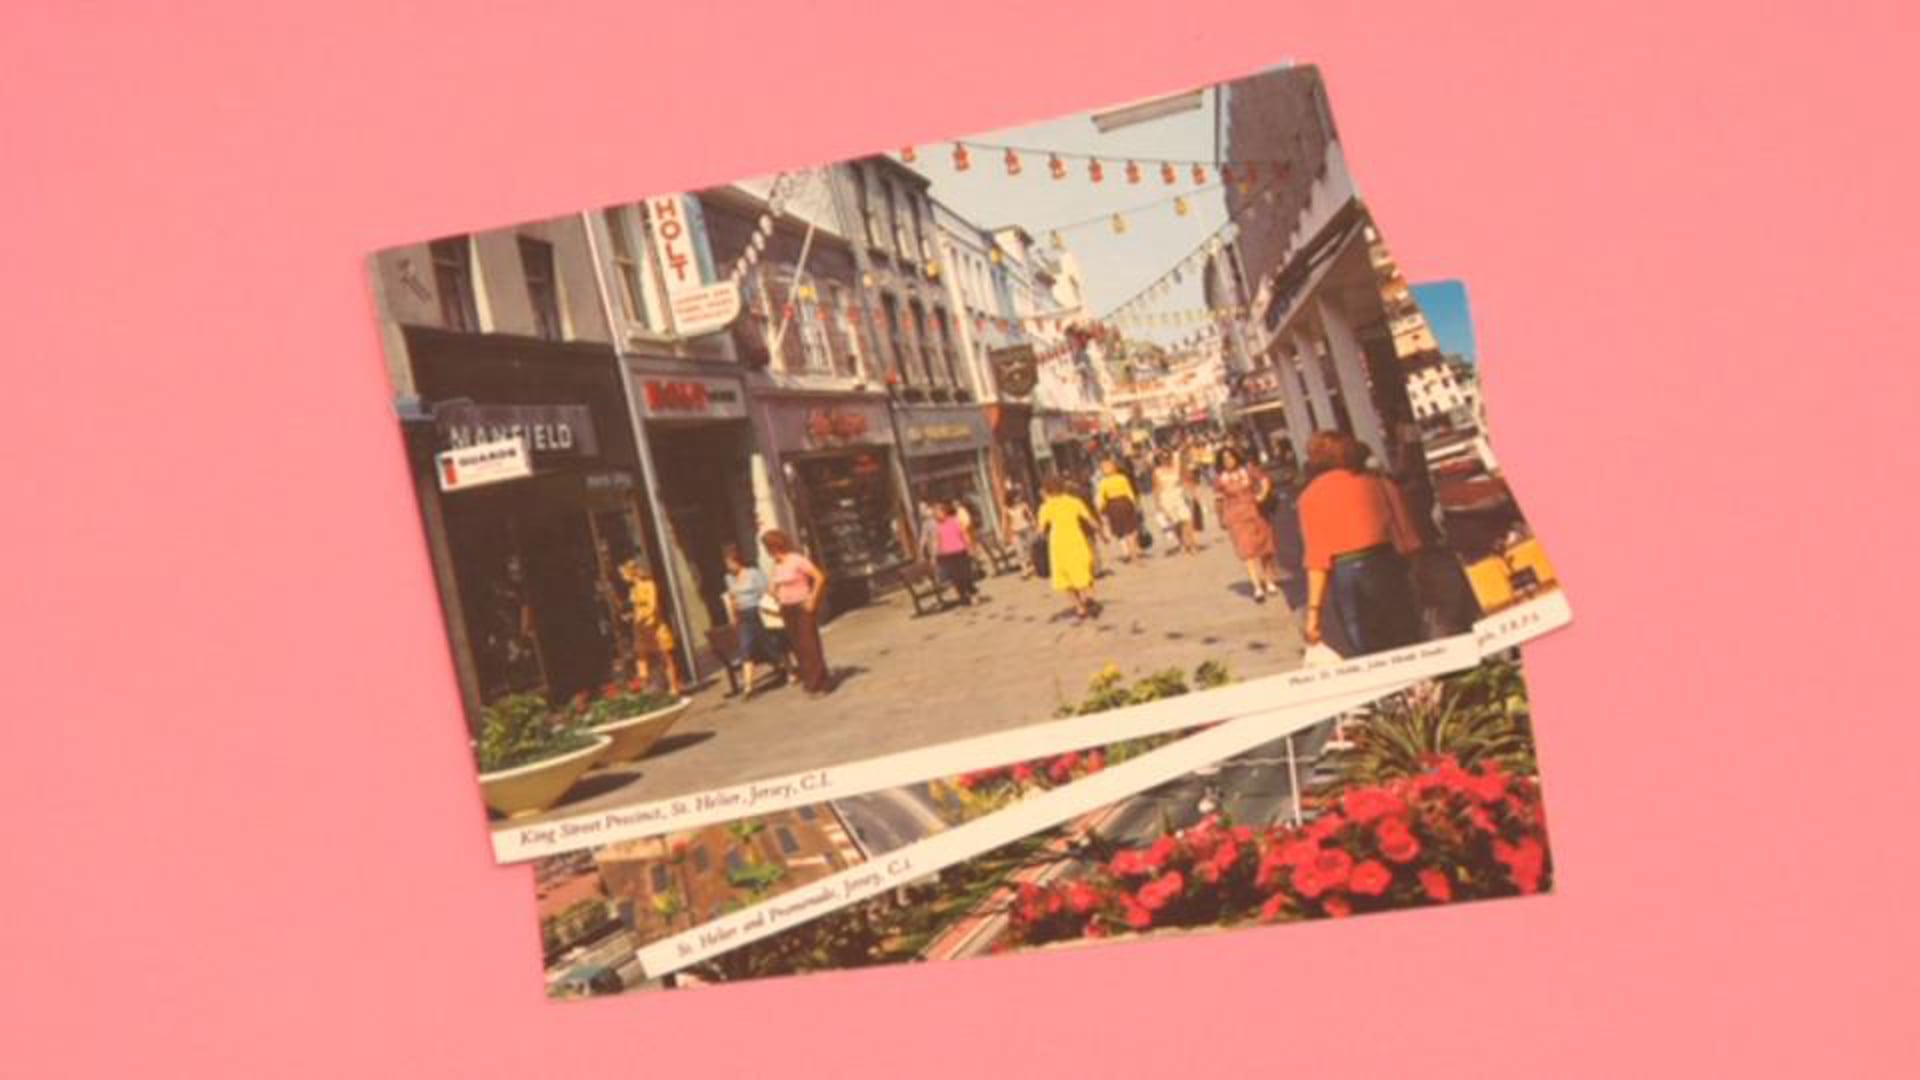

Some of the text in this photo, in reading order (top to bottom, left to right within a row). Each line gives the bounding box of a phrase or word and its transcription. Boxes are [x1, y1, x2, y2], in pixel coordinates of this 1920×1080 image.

[654, 197, 687, 281] HOLT
[520, 828, 557, 847] King
[560, 818, 601, 836] Street
[606, 807, 668, 829] Precinct,
[671, 801, 691, 816] St.
[695, 792, 747, 813] Helier,
[750, 783, 799, 806] Jersey,
[699, 925, 737, 946] Helier
[744, 911, 765, 927] and
